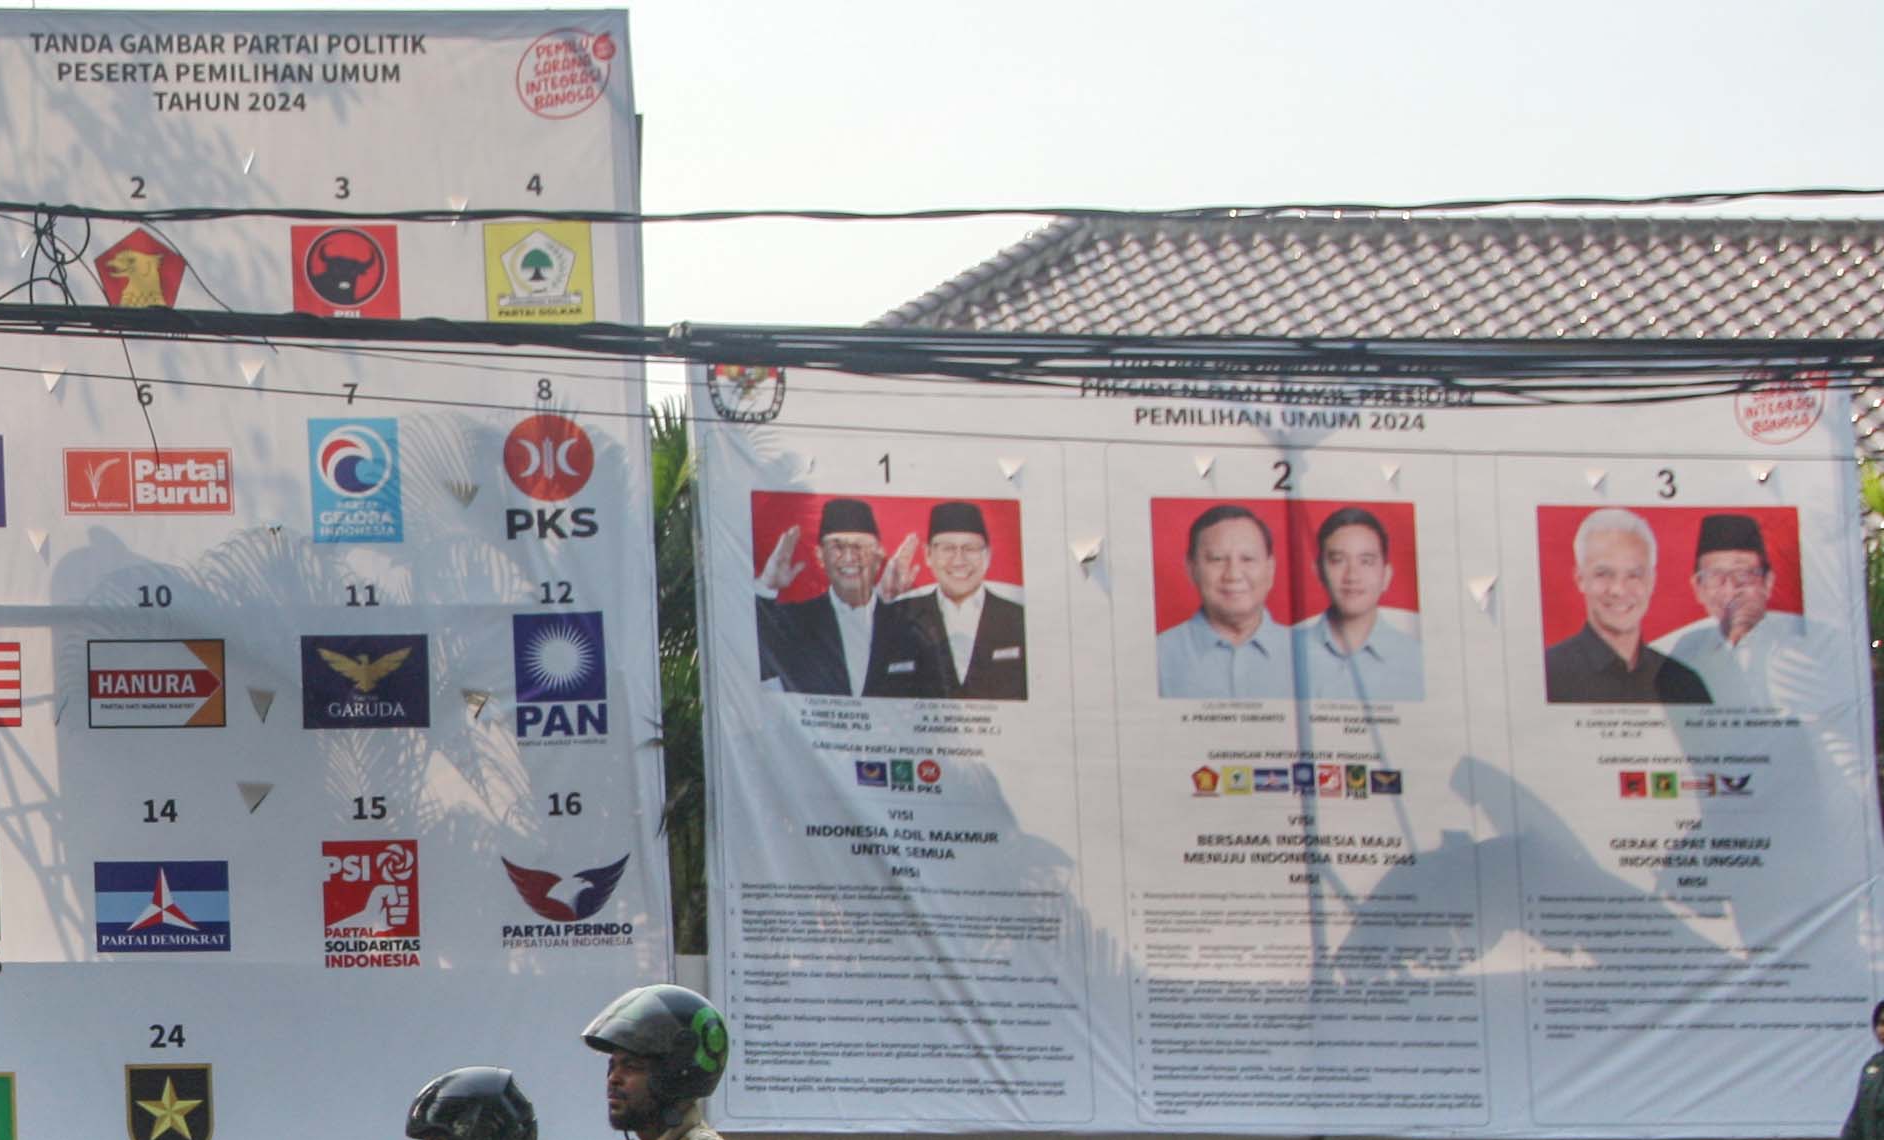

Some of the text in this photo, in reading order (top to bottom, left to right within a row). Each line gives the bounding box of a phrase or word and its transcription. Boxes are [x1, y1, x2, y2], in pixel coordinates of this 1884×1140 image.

[29, 33, 427, 55] TANDA GAMBAR PARTAI POLITIK
[58, 62, 401, 84] PESERTA PEMILIHAN UMUM
[154, 91, 307, 112] TAHUN 2024
[129, 176, 147, 199] 2
[334, 176, 351, 200] 3
[525, 173, 544, 197] 4
[136, 383, 154, 406] 6
[342, 382, 359, 405] 7
[536, 378, 553, 401] 8
[1134, 406, 1427, 431] PEMILIHAN UMUM 2024
[134, 458, 227, 482] Partai
[877, 453, 892, 484] 1
[1271, 461, 1293, 491] 2
[134, 481, 229, 505] Buruh
[1657, 469, 1677, 499] 3
[505, 507, 600, 541] PKS
[136, 584, 173, 609] 10
[344, 584, 381, 608] 11
[539, 580, 575, 605] 12
[97, 673, 198, 695] HANURA
[327, 701, 406, 719] GARUDA
[516, 702, 609, 738] PAN
[141, 798, 179, 824] 14
[351, 796, 388, 821] 15
[546, 791, 583, 817] 16
[888, 808, 915, 822] VISI
[805, 824, 999, 845] INDONESIA ADIL MAKMUR
[1196, 834, 1271, 848] BERSAMA
[851, 843, 956, 860] UNTUK SEMUA
[322, 854, 371, 883] PSI
[890, 865, 922, 879] MISI
[101, 932, 227, 947] PARTAI DEMOKRAT
[324, 926, 375, 939] PARTAI
[502, 922, 634, 939] PARTAI PERINDO
[502, 935, 634, 949] PERSATUAN INDONESIA
[324, 938, 421, 954] SOLIDARITAS
[324, 953, 421, 969] INDONESIA
[148, 1023, 187, 1049] 24
